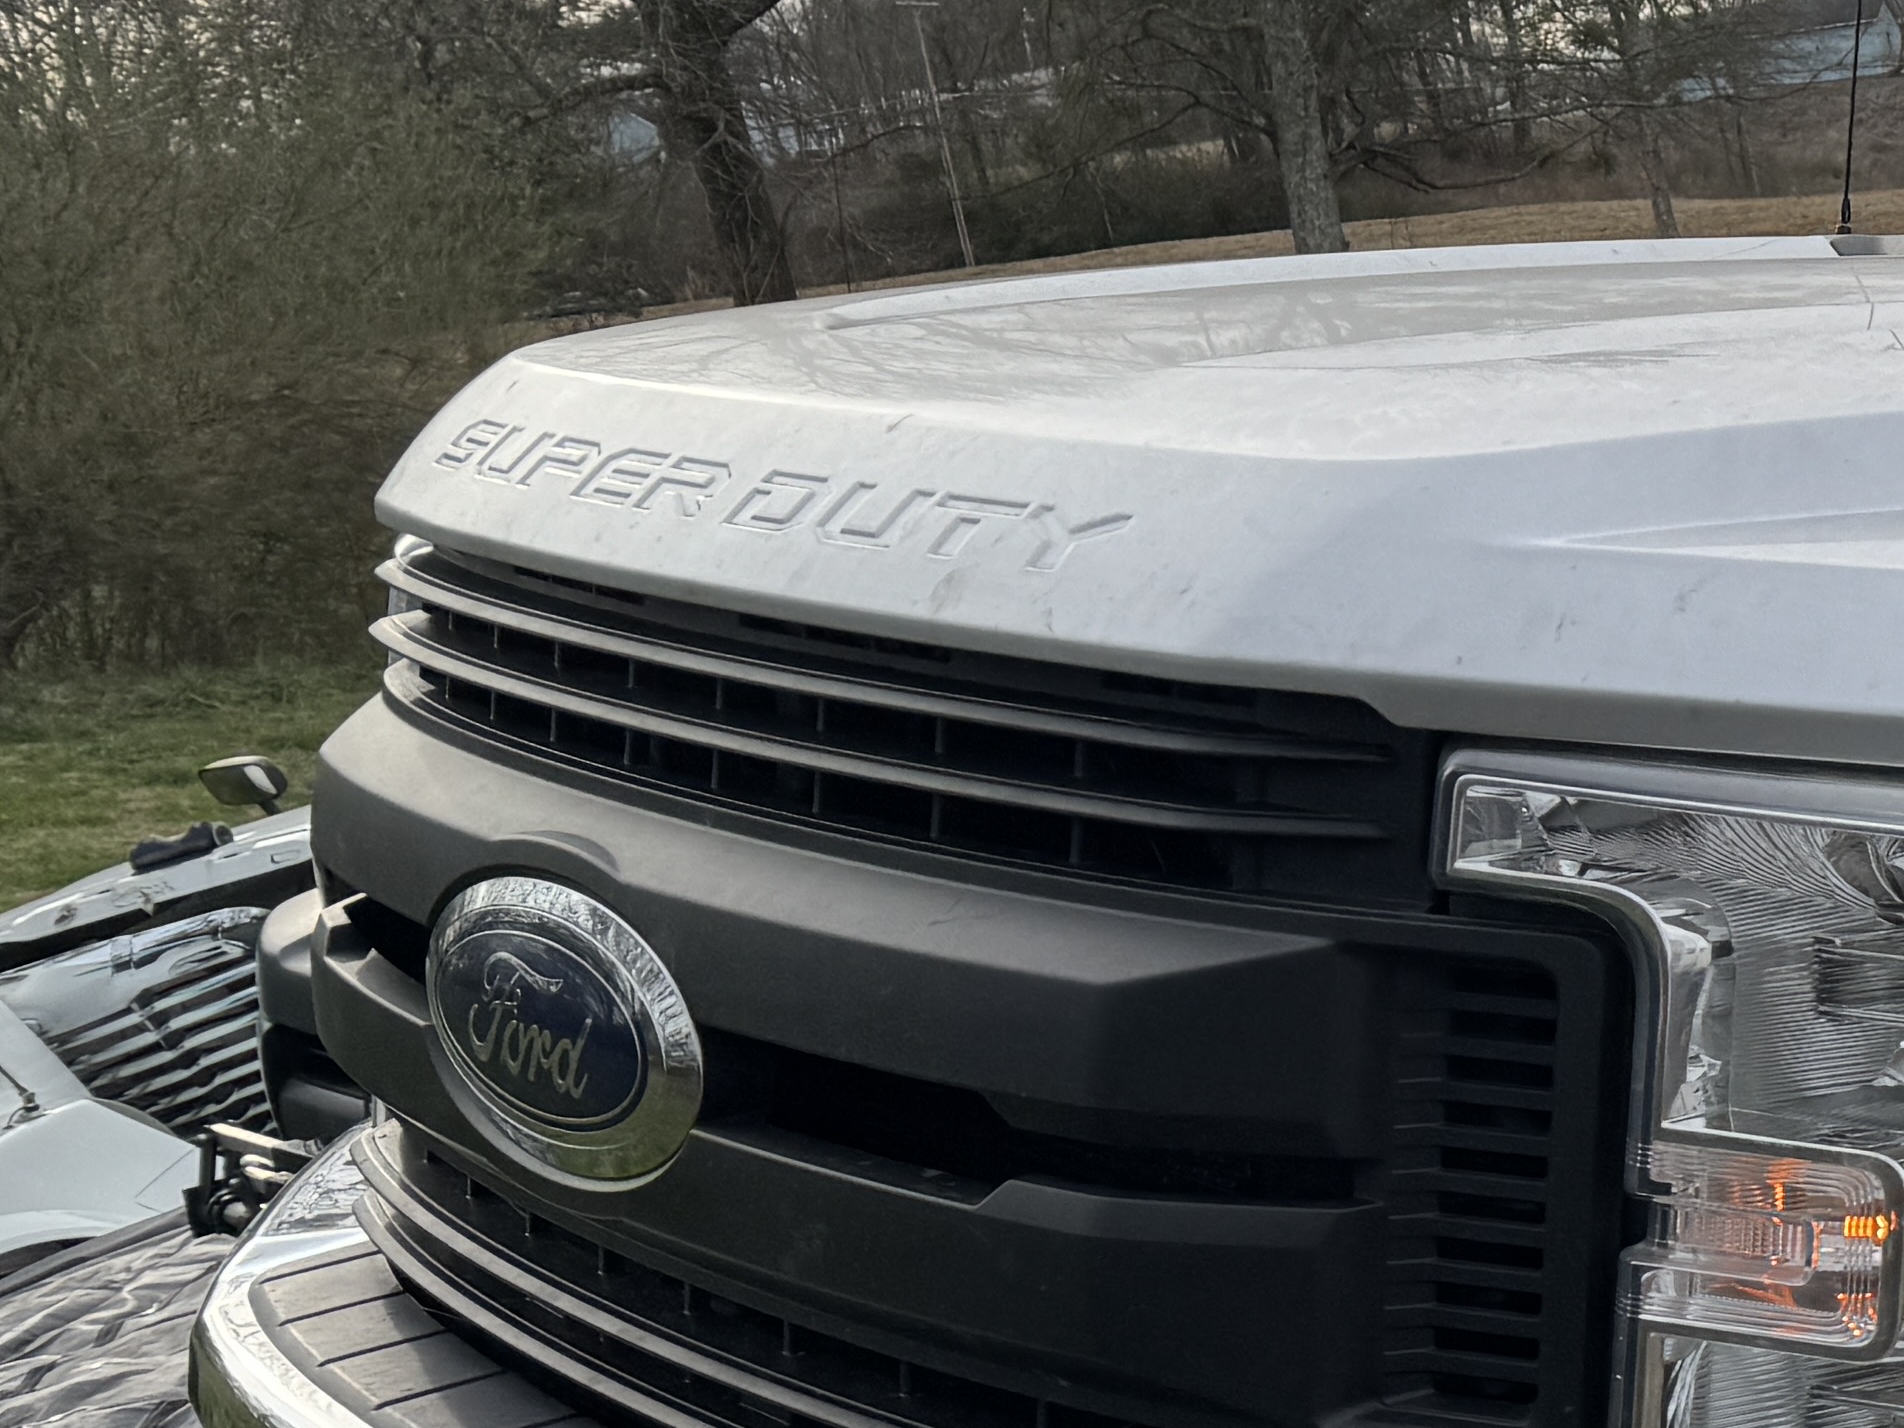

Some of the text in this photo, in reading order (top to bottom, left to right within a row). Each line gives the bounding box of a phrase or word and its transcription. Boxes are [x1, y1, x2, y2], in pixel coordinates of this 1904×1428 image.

[431, 417, 1136, 573] SUPER DUTY
[468, 951, 592, 1100] Ford
